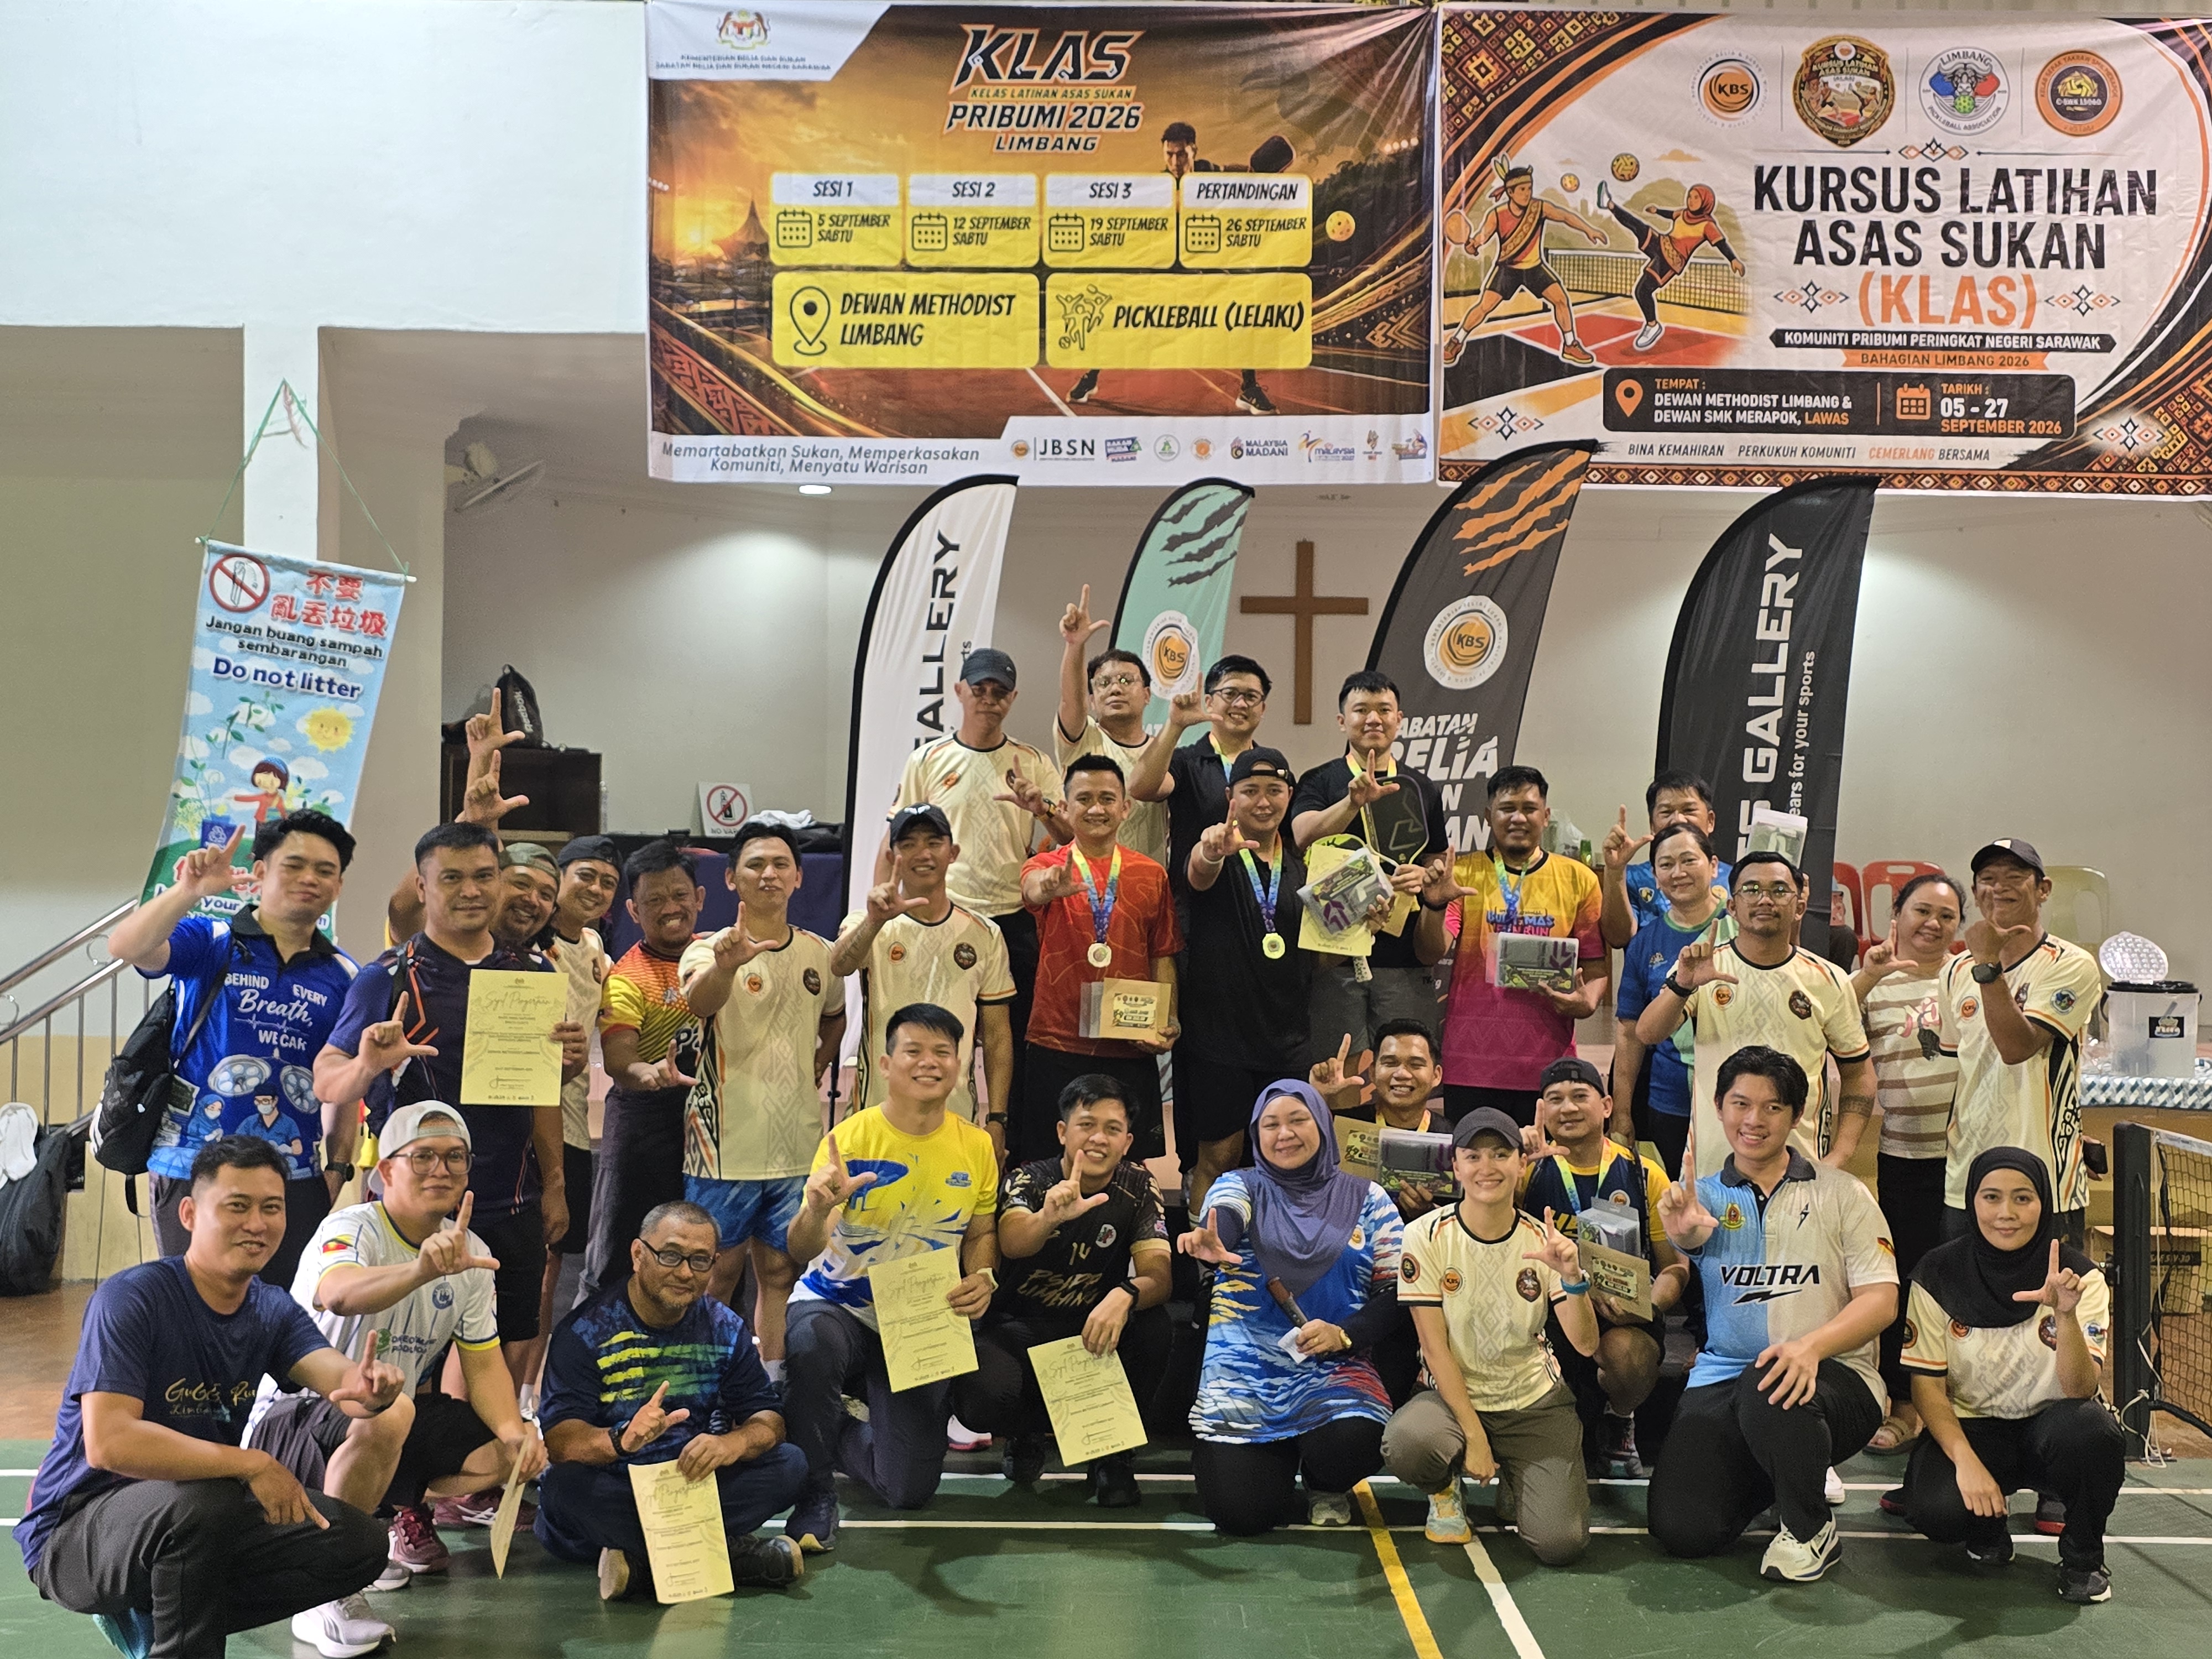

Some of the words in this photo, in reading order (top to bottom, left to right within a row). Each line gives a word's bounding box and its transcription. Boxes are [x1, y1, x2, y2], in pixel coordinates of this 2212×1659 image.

[951, 25, 1142, 92] KLAS
[1939, 50, 1992, 67] LIMBANG
[971, 88, 1007, 98] KELAS
[1010, 88, 1058, 99] LATIHAN
[1061, 88, 1091, 99] ASAS
[1093, 88, 1132, 99] SUKAN
[1718, 83, 1749, 97] KBS
[947, 104, 1066, 131] PRIBUMI
[1068, 105, 1141, 130] 2026
[995, 135, 1098, 151] LIMBANG
[813, 181, 842, 197] SESI
[846, 181, 854, 197] 1
[952, 181, 983, 197] SESI
[985, 182, 997, 197] 2
[1089, 181, 1119, 198] SESI
[1121, 182, 1133, 198] 3
[1197, 182, 1298, 201] PERTANDINGAN
[1754, 165, 1942, 213] KURSUS
[1960, 168, 2157, 216] LATIHAN
[818, 215, 826, 227] 5
[828, 214, 891, 228] SEPTEMBER
[953, 217, 967, 231] 12
[969, 217, 1031, 231] SEPTEMBER
[1089, 218, 1104, 231] 19
[1107, 217, 1168, 231] SEPTEMBER
[1225, 219, 1242, 232] 26
[1244, 217, 1307, 232] SEPTEMBER
[817, 230, 853, 243] SABTU
[952, 232, 988, 246] SABTU
[1089, 233, 1126, 247] SABTU
[1225, 234, 1261, 248] SABTU
[1793, 219, 1923, 267] ASAS
[1940, 221, 2106, 269] SUKAN
[840, 293, 906, 315] DEWAN
[910, 293, 1016, 316] METHODIST
[1859, 271, 2037, 329] (KLAS)
[1113, 304, 1218, 328] PICKLEBALL
[1224, 300, 1305, 332] (LELAKI)
[840, 324, 924, 347] LIMBANG
[1785, 332, 1849, 345] KOMUNITI
[1852, 333, 1908, 347] PRIBUMI
[1910, 334, 1983, 348] PERINGKAT
[1985, 336, 2033, 349] NEGERI
[2036, 336, 2101, 349] SARAWAK
[1861, 353, 1931, 366] BAHAGIAN
[1935, 354, 1995, 366] LIMBANG
[1999, 356, 2030, 367] 2026
[1655, 378, 1699, 389] TEMPAT
[1941, 383, 1983, 395] TARIKH
[1654, 393, 1702, 406] DEWAN
[1705, 394, 1779, 408] METHODIST
[1782, 395, 1840, 409] LIMBANG
[1842, 397, 1852, 409] &
[1940, 397, 1966, 418] 05
[1984, 398, 2008, 418] 27
[1654, 410, 1702, 423] DEWAN
[1704, 410, 1733, 423] SMK
[1736, 411, 1802, 426] MERAPOK,
[1804, 412, 1849, 425] LAWAS
[1940, 419, 2026, 434] SEPTEMBER
[2028, 420, 2062, 435] 2026
[662, 443, 787, 460] Memartabatkan
[791, 445, 845, 461] Sukan,
[848, 447, 980, 463] Memperkasakan
[1039, 439, 1095, 456] JBSN
[1245, 447, 1288, 457] MADANI
[1629, 444, 1654, 456] BINA
[1658, 444, 1725, 457] KEMAHIRAN
[1738, 445, 1798, 458] PERKUKUH
[1801, 446, 1856, 459] KOMUNITI
[1869, 447, 1935, 460] CEMERLANG
[1938, 448, 1990, 461] BERSAMA
[711, 457, 784, 475] Komuniti,
[789, 459, 859, 477] Menyatu
[863, 460, 928, 474] Warisan
[306, 569, 363, 602] 不要
[206, 615, 262, 637] Jangan
[267, 628, 316, 647] buang
[320, 638, 383, 658] sampah
[1456, 633, 1485, 649] KBS
[237, 639, 347, 667] sembarangan
[1164, 645, 1185, 664] KBS
[1743, 533, 1803, 783] GALLERY
[213, 657, 247, 679] Do
[253, 667, 295, 688] not
[301, 673, 361, 698] litter
[1799, 650, 1815, 706] sports
[1395, 713, 1479, 739] ABATAN
[1794, 707, 1808, 750] your
[1788, 752, 1806, 779] for
[1788, 781, 1804, 818] ears
[203, 897, 240, 911] your
[1524, 925, 1550, 936] RUN
[224, 973, 270, 990] BEHIND
[292, 984, 328, 1007] EVERY
[237, 988, 313, 1027] Breath,
[258, 1029, 278, 1046] WE
[1720, 1264, 1820, 1286] VOLTRA
